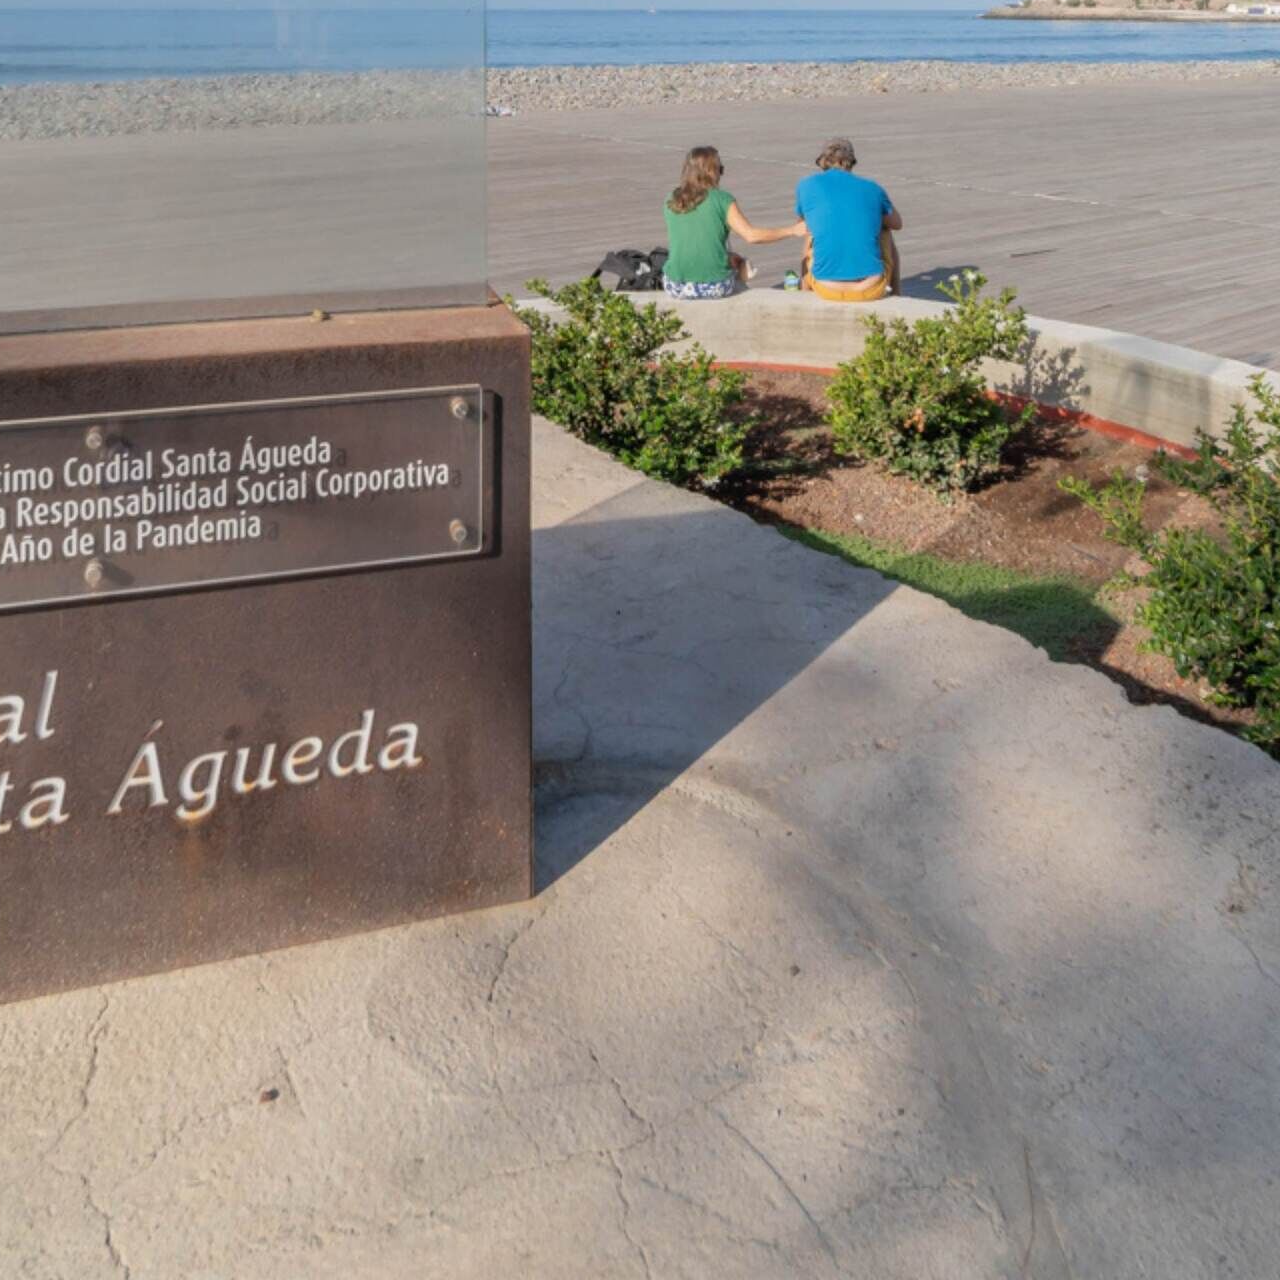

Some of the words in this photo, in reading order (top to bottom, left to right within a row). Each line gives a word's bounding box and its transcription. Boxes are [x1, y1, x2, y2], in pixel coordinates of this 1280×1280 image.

[63, 450, 152, 488] Cordial
[161, 447, 231, 479] Santa
[240, 435, 331, 475] Águeda
[16, 479, 227, 528] Responsabilidad
[236, 471, 307, 506] Social
[316, 458, 449, 497] Corporativa
[0, 534, 52, 565] Año
[62, 528, 94, 557] de
[104, 523, 127, 553] la
[137, 513, 261, 549] Pandemia
[108, 710, 422, 820] Águeda
